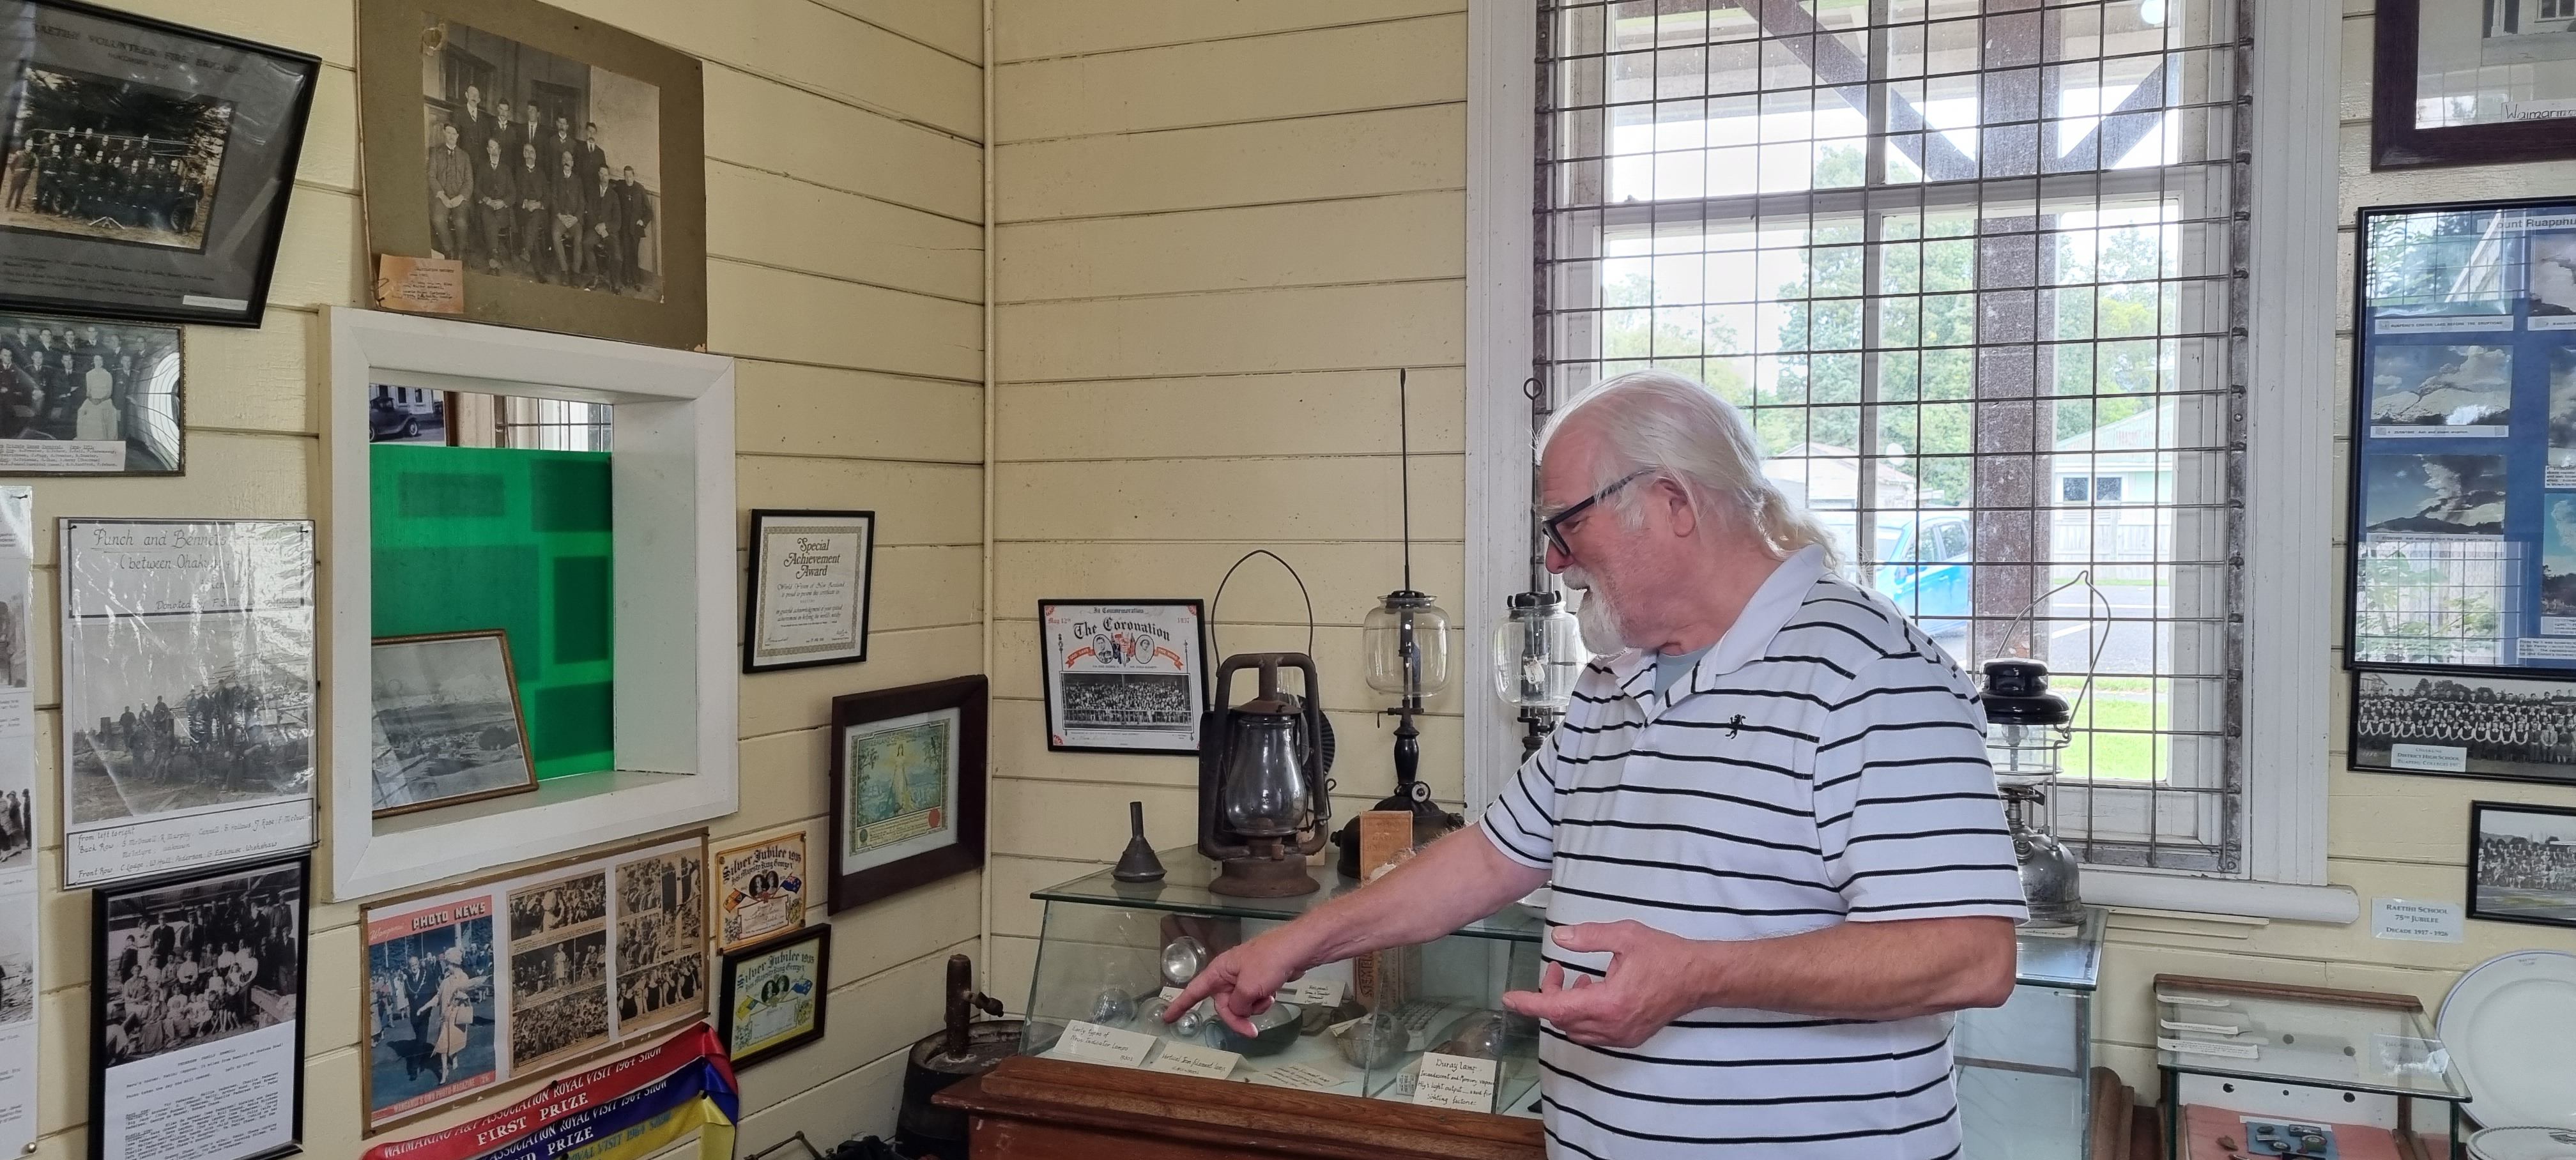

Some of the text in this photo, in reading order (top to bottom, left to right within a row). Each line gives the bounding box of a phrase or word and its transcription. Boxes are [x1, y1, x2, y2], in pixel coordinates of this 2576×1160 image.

[88, 34, 157, 57] VOLUNTEER
[94, 528, 134, 546] Punch
[143, 530, 167, 546] and
[797, 537, 830, 553] Special
[119, 554, 171, 570] (between
[783, 552, 841, 567] Achievement
[795, 565, 828, 579] Award
[1073, 616, 1170, 641] The Coronation
[78, 834, 95, 847] from
[79, 845, 96, 854] Back
[99, 843, 114, 852] Row
[723, 855, 753, 885] Silver
[753, 845, 787, 864] Jubilee
[761, 860, 774, 869] King
[773, 858, 790, 870] George
[78, 867, 97, 878] Front
[99, 867, 113, 876] Row
[411, 901, 486, 931] PHOTO NEWS
[2386, 904, 2416, 912] RAETIHI
[2411, 915, 2439, 923] JUBILEE
[737, 949, 815, 989] Silver Jubilee 1935
[1072, 1025, 1086, 1035] Early
[1085, 1037, 1111, 1048] Indicator
[553, 1076, 584, 1098] ROYAL
[586, 1067, 611, 1085] VISIT
[476, 1092, 588, 1147] FIRST PRIZE
[560, 1110, 590, 1133] ROYAL
[593, 1101, 617, 1118] VISIT
[547, 1126, 594, 1156] PRIZE
